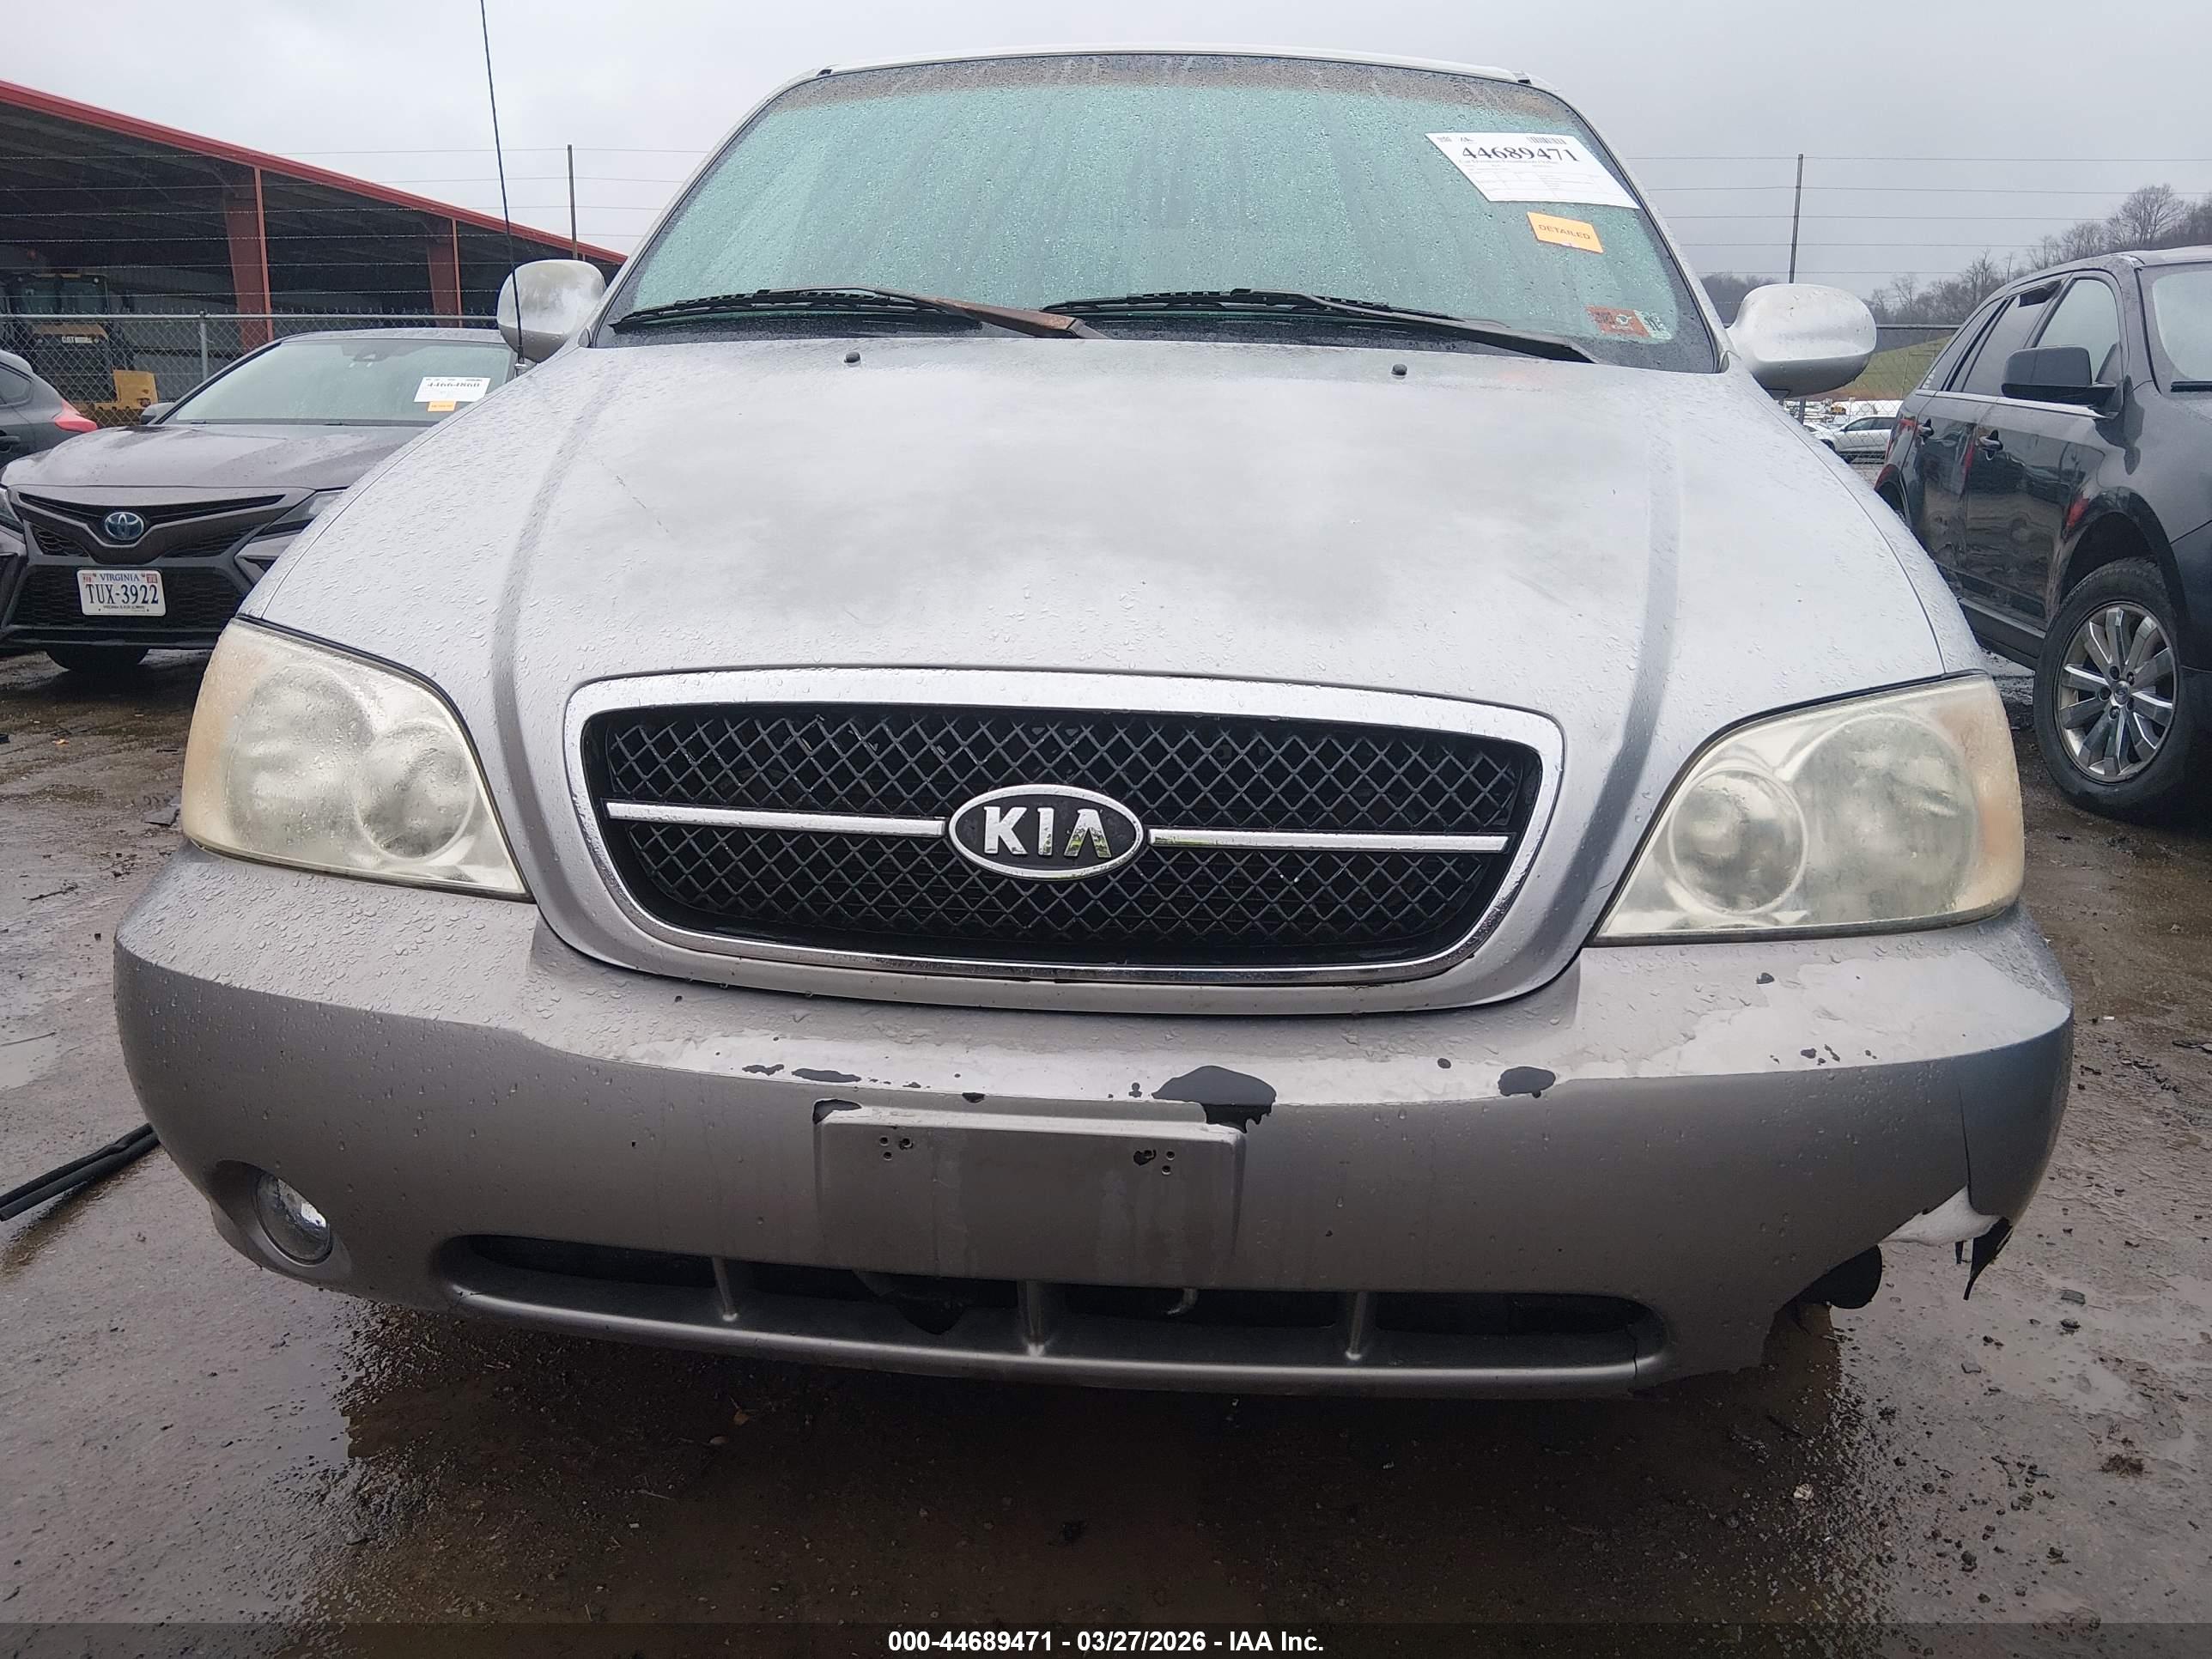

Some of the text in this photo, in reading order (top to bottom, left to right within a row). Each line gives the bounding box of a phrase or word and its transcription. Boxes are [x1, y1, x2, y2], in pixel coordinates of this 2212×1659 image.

[1462, 147, 1581, 162] 44689471
[1538, 224, 1591, 240] DETAILED
[99, 573, 140, 581] VIRGINIA
[85, 584, 159, 604] TUX-3922
[983, 805, 1112, 858] KIA
